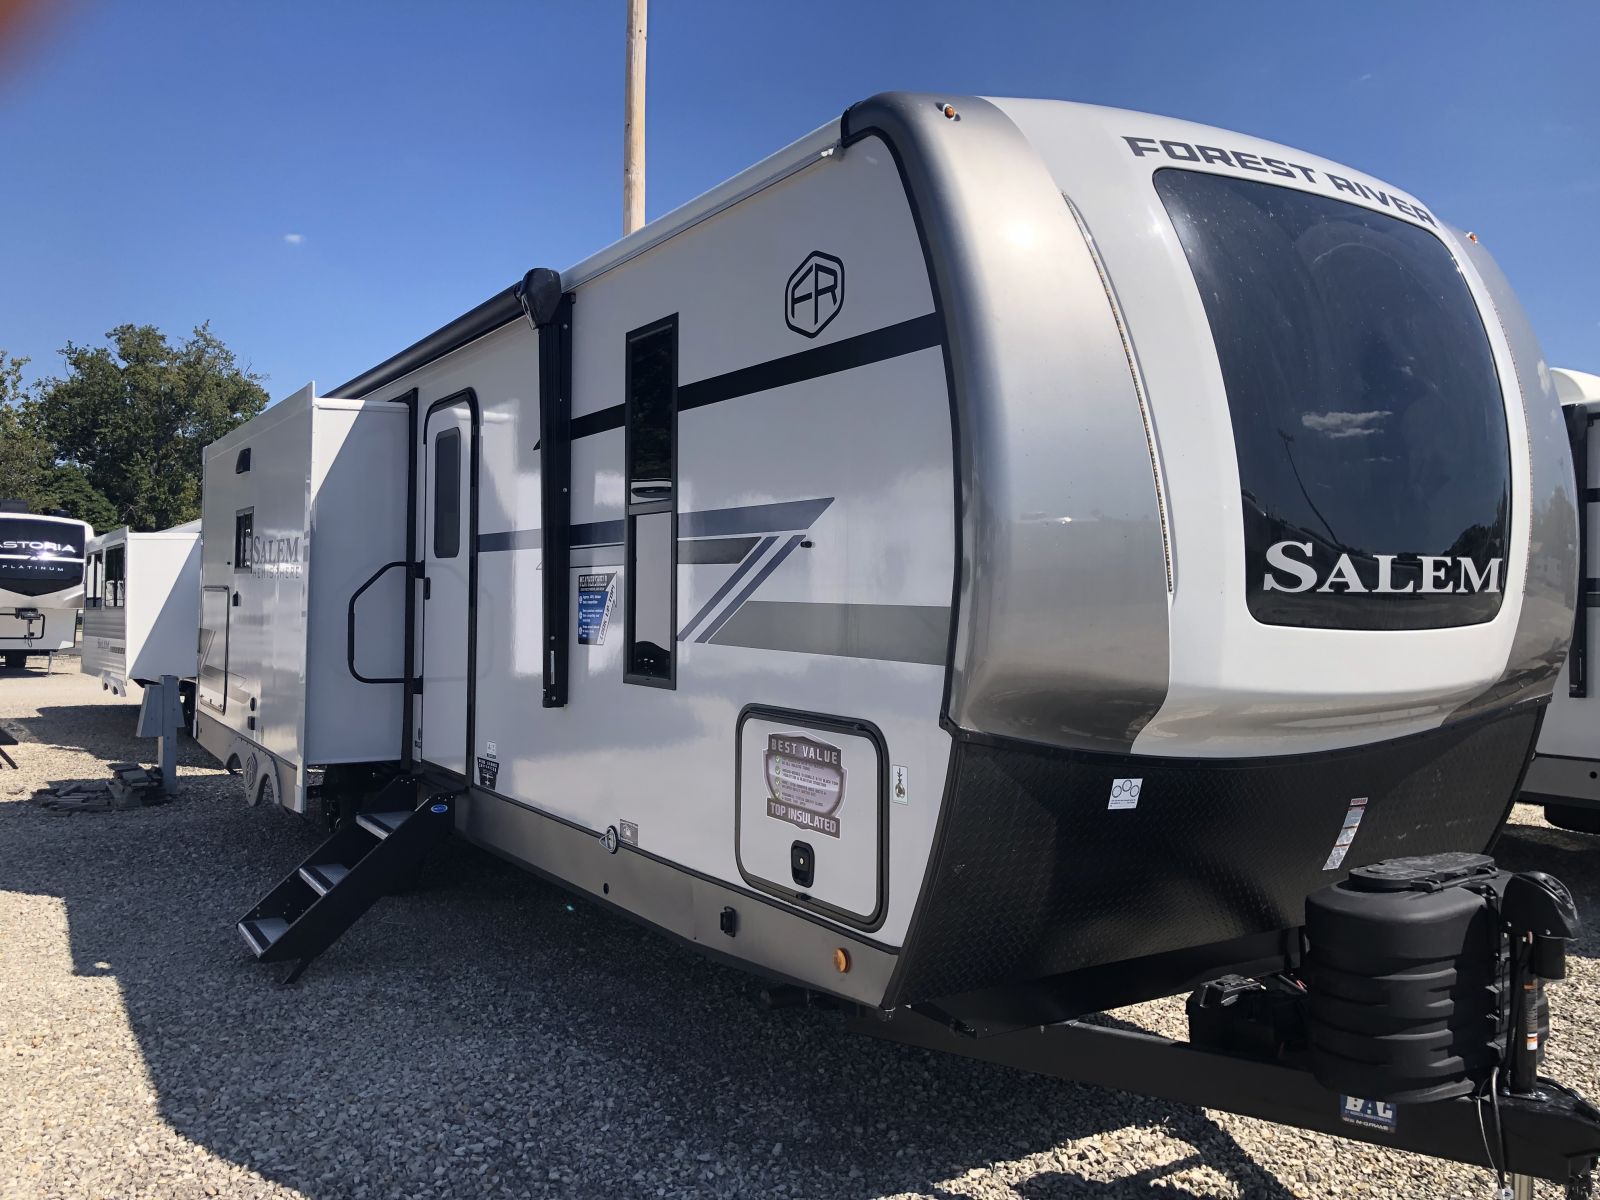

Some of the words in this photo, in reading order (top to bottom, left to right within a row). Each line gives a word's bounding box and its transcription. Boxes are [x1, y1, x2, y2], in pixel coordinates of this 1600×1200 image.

[1121, 135, 1316, 184] FOREST
[1322, 171, 1440, 228] RIVER
[0, 541, 76, 553] STORIA
[252, 535, 300, 565] SALEM
[2, 564, 64, 572] PLATINUM
[1262, 540, 1503, 593] SALEM
[771, 738, 797, 755] BEST
[802, 745, 838, 764] VALUE
[770, 802, 786, 816] TOP
[788, 807, 837, 833] INSULATED
